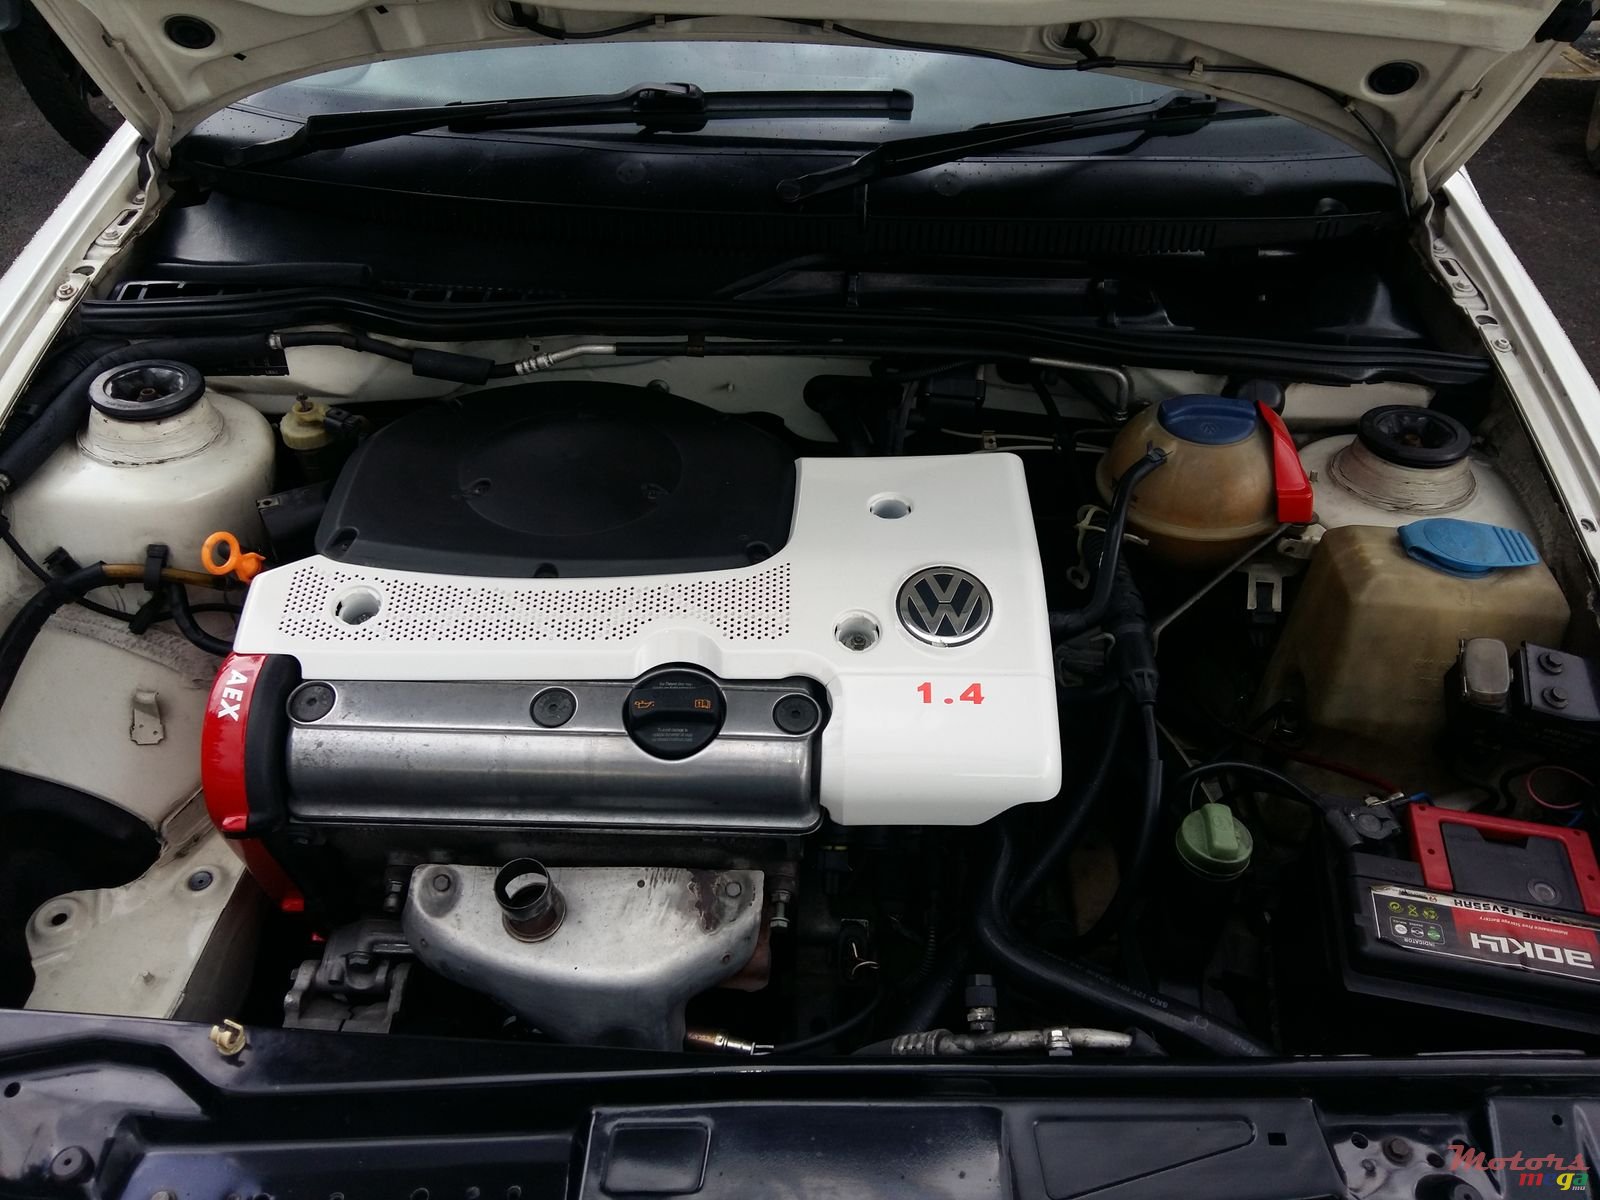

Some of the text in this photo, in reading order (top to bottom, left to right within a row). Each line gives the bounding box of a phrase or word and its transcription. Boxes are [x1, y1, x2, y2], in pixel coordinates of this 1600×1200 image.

[217, 669, 248, 722] AEX
[917, 682, 985, 705] 1.4
[1403, 937, 1435, 947] INDICATOR
